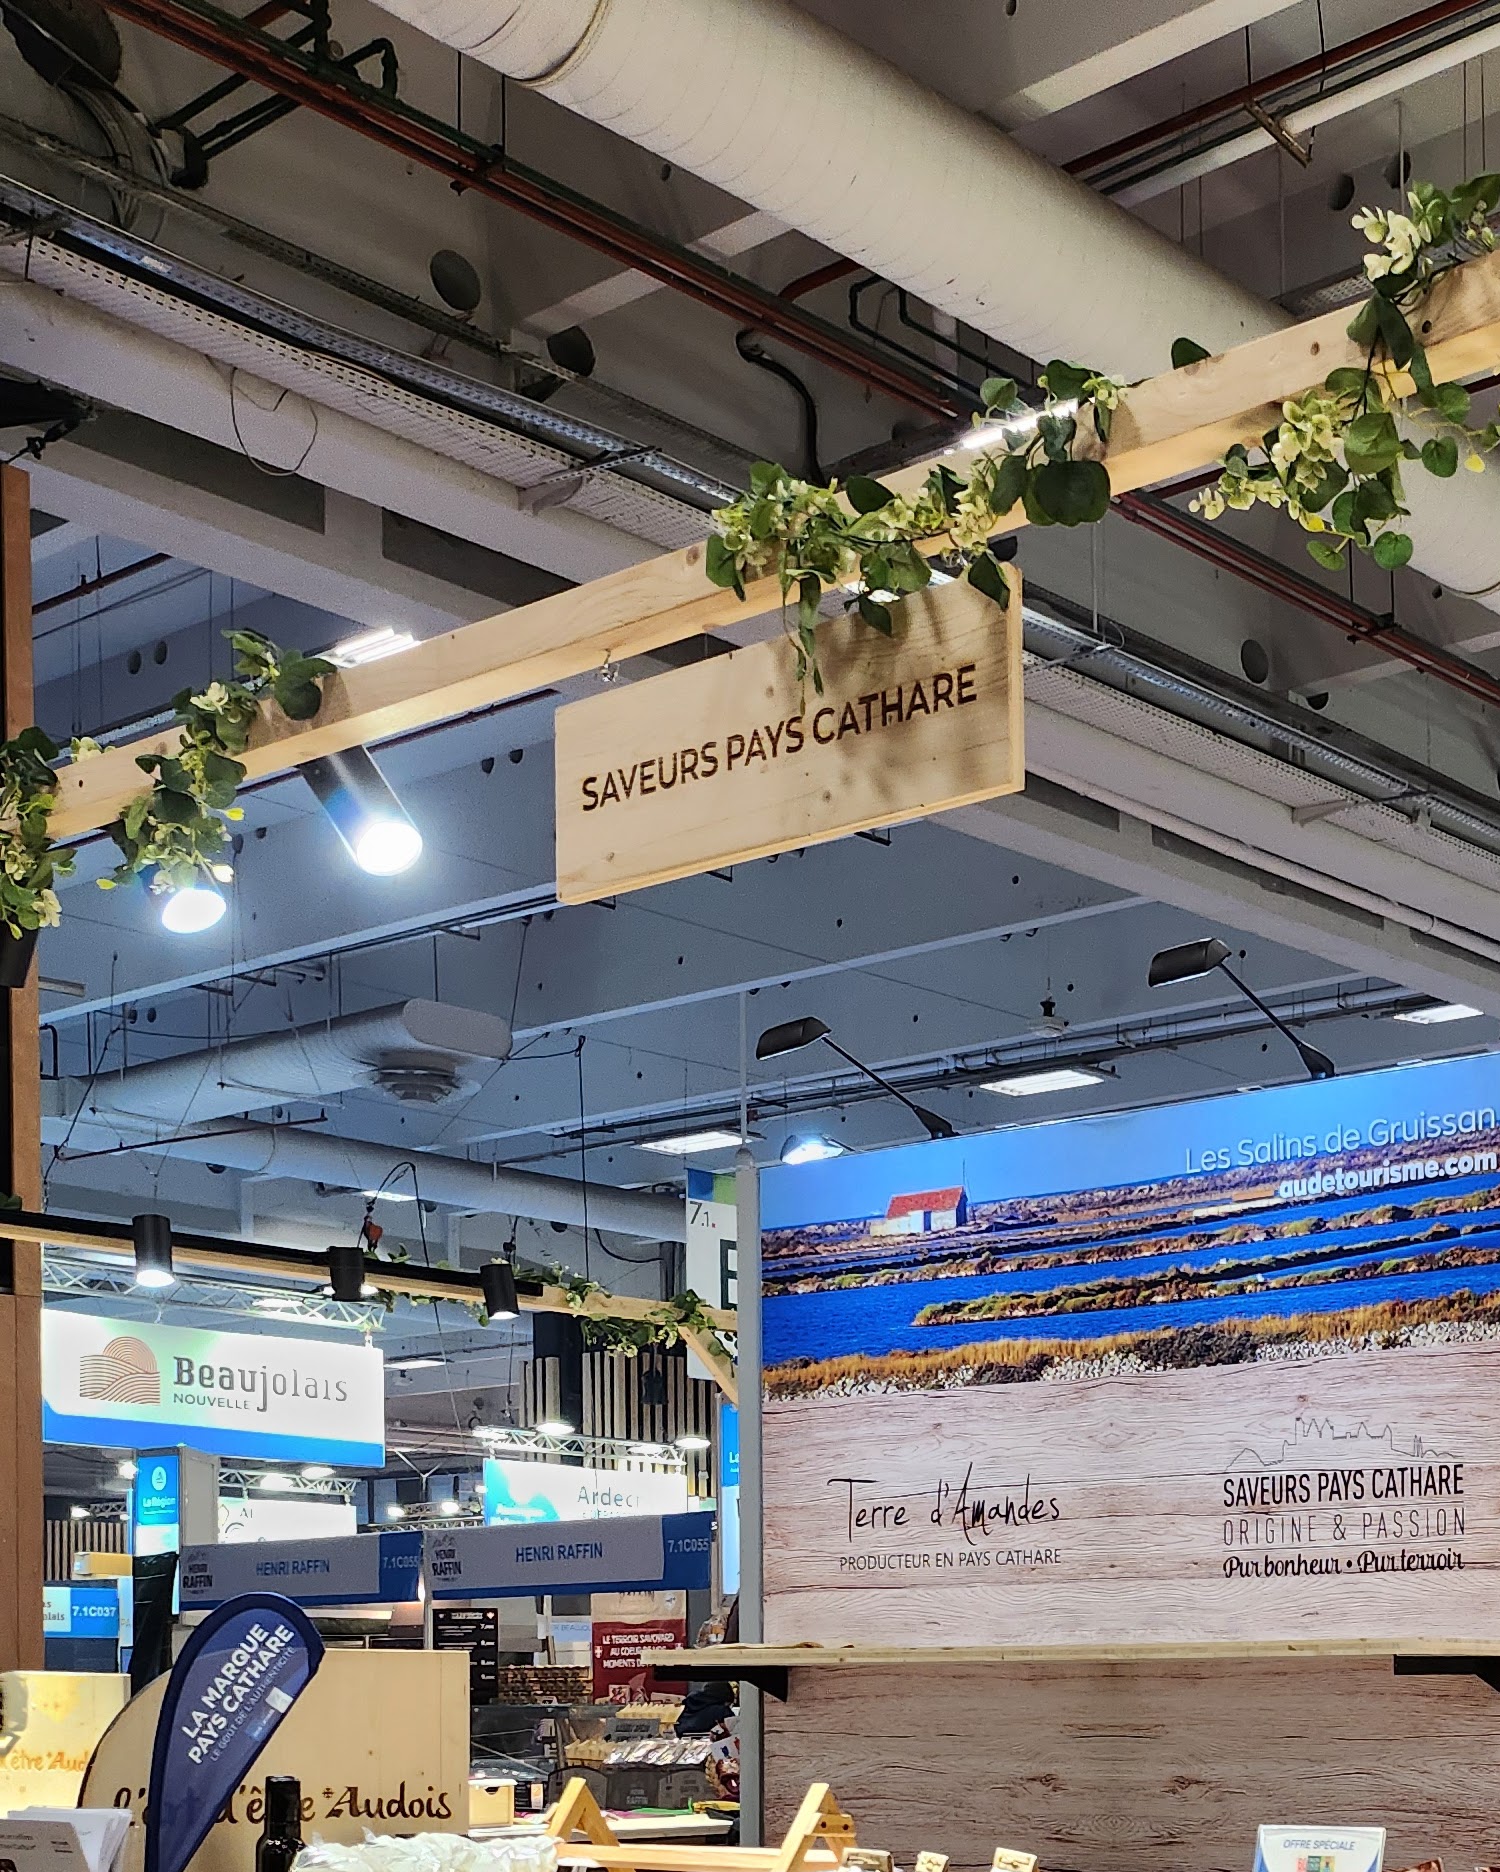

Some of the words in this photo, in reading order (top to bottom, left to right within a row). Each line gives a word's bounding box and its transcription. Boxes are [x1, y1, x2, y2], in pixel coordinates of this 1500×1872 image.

[582, 741, 718, 811] SAVEURS
[727, 716, 804, 771] PAYS
[813, 664, 977, 745] CATHARE
[1185, 1148, 1231, 1174] Les
[1238, 1133, 1317, 1167] Salins
[1324, 1124, 1362, 1153] de
[1368, 1107, 1497, 1147] Gruissan
[1279, 1151, 1498, 1199] audetourisme.com
[174, 1356, 348, 1412] Beaujolais
[174, 1393, 250, 1410] NOUVELLE
[1223, 1473, 1310, 1508] SAVEURS
[1318, 1470, 1365, 1502] PAYS
[1372, 1464, 1464, 1499] CATHARE
[827, 1477, 910, 1543] Terre
[930, 1461, 1060, 1546] d'Amandes
[1223, 1515, 1317, 1546] ORIGINE
[1333, 1513, 1347, 1541] &
[1363, 1507, 1465, 1540] PASSION
[255, 1560, 290, 1576] HENRI
[292, 1559, 330, 1575] RAFFIN
[432, 1561, 462, 1576] RAFFIN
[515, 1545, 554, 1562] HENRI
[557, 1541, 603, 1560] RAFFIN
[840, 1554, 931, 1571] PRODUCTEUR
[936, 1553, 953, 1568] EN
[959, 1551, 991, 1567] PAYS
[995, 1548, 1061, 1565] CATHARE
[1264, 1553, 1342, 1577] bonheur
[1401, 1548, 1465, 1572] terroir
[182, 1574, 213, 1589] RAFFIN
[72, 1605, 116, 1617] 7.1C037
[182, 1710, 208, 1739] LA
[201, 1623, 270, 1709] MARQUE
[188, 1713, 228, 1764] PAYS
[222, 1624, 295, 1713] CATHARE
[48, 1750, 89, 1772] Aud
[325, 1781, 452, 1820] Audois
[1283, 1839, 1311, 1849] OFFRE
[1313, 1838, 1355, 1850] SPÉCIALE
